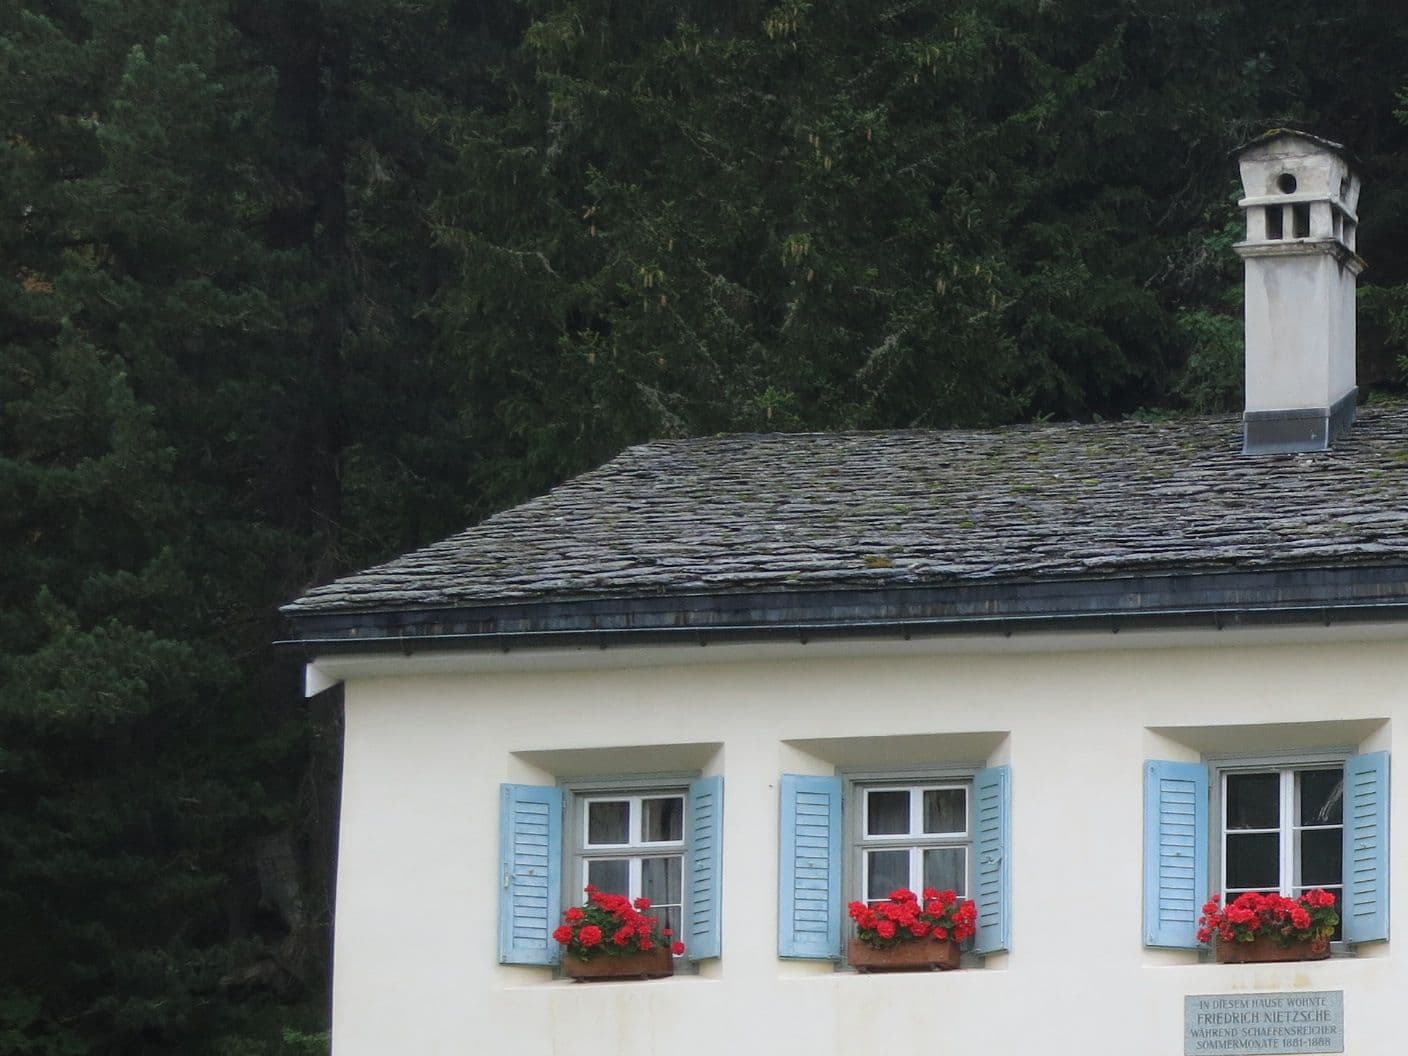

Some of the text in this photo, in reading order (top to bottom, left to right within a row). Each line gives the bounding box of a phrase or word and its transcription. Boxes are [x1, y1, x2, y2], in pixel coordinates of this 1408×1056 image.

[1200, 997, 1327, 1010] IN DIESEM HAUSE WOHNTE
[1197, 1010, 1332, 1025] FRIEDRICH NIETZSCHE
[1242, 1025, 1337, 1037] SCHAFFENSREICHER
[1196, 1038, 1279, 1050] SOMMERMONATE
